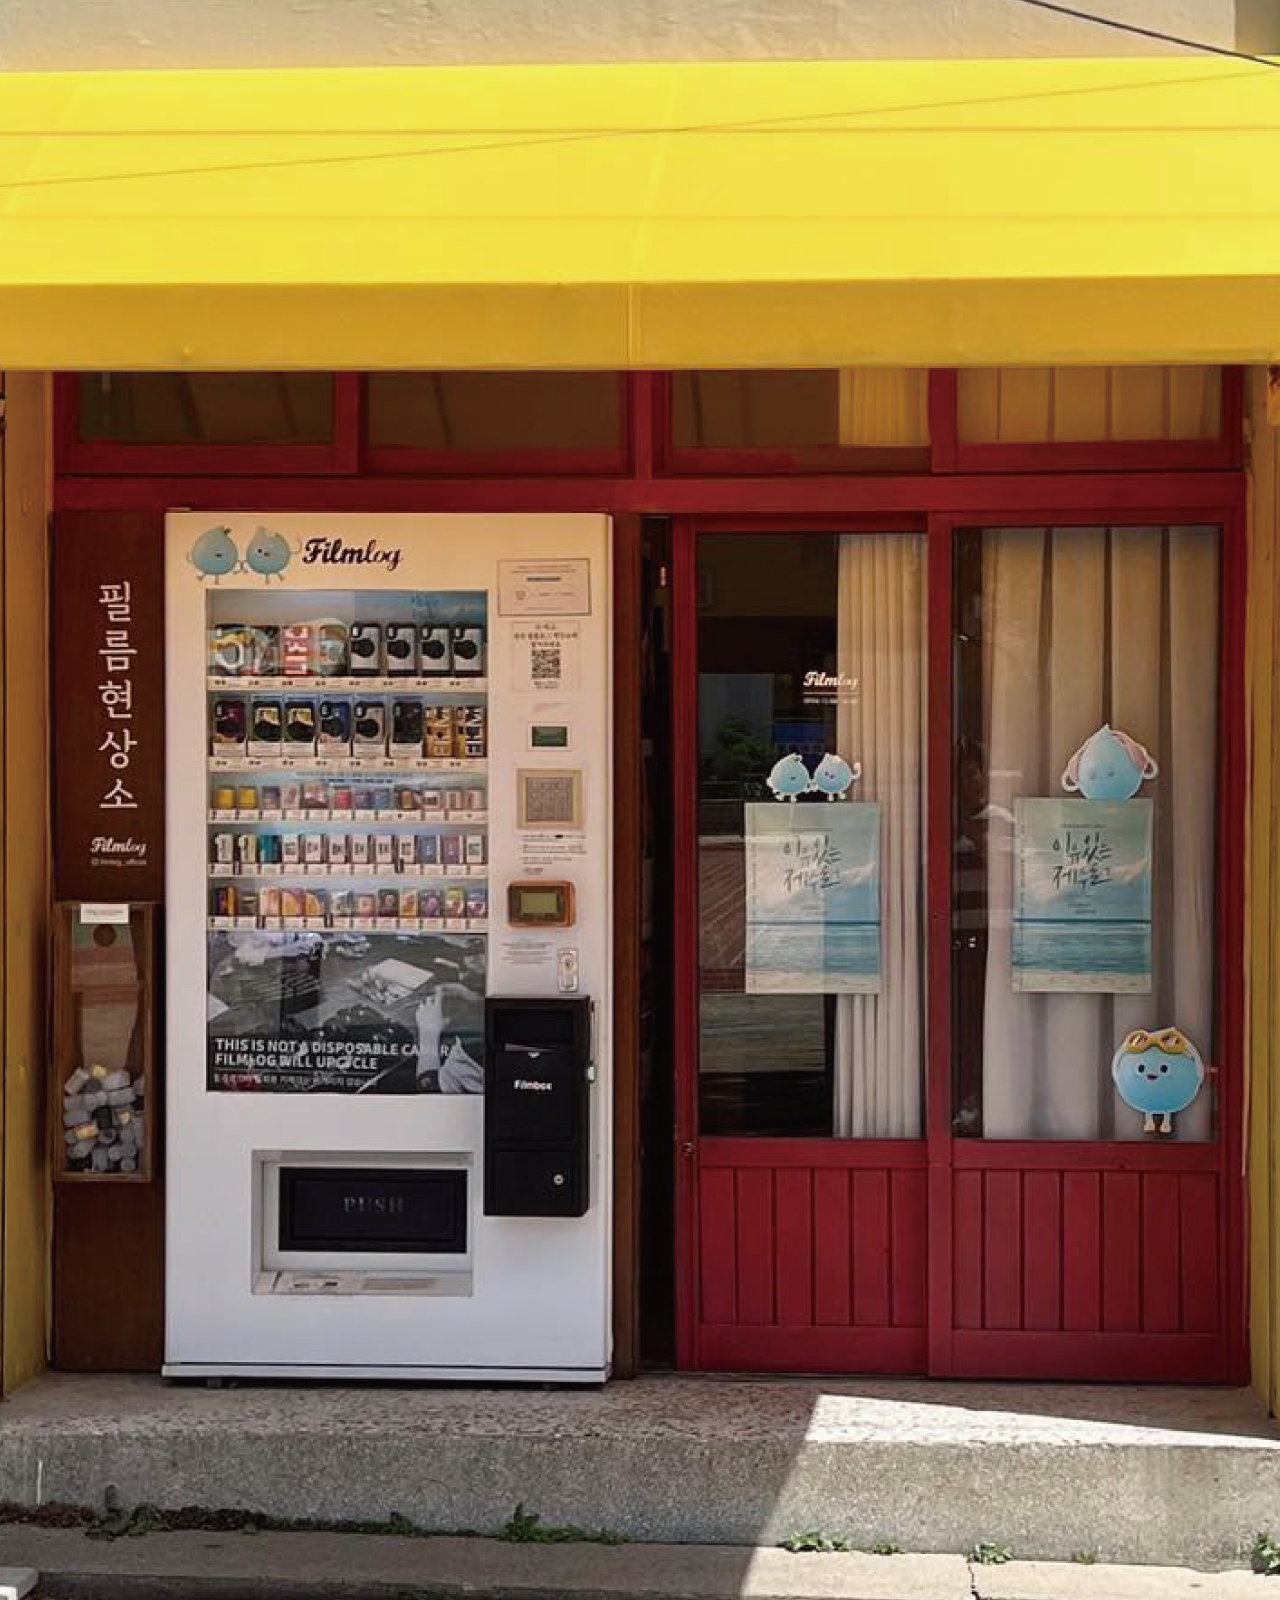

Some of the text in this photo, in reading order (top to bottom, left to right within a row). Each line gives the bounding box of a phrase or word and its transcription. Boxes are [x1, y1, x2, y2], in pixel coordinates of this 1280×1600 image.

[302, 536, 402, 571] Filmlog
[803, 671, 859, 690] Filmlog
[98, 580, 138, 809] 필름현상소
[90, 836, 147, 857] Filmlog
[214, 1037, 249, 1052] THIS
[251, 1038, 265, 1053] IS
[267, 1039, 297, 1053] NOT
[279, 1053, 314, 1068] WILL
[343, 1196, 404, 1213] PUSH
